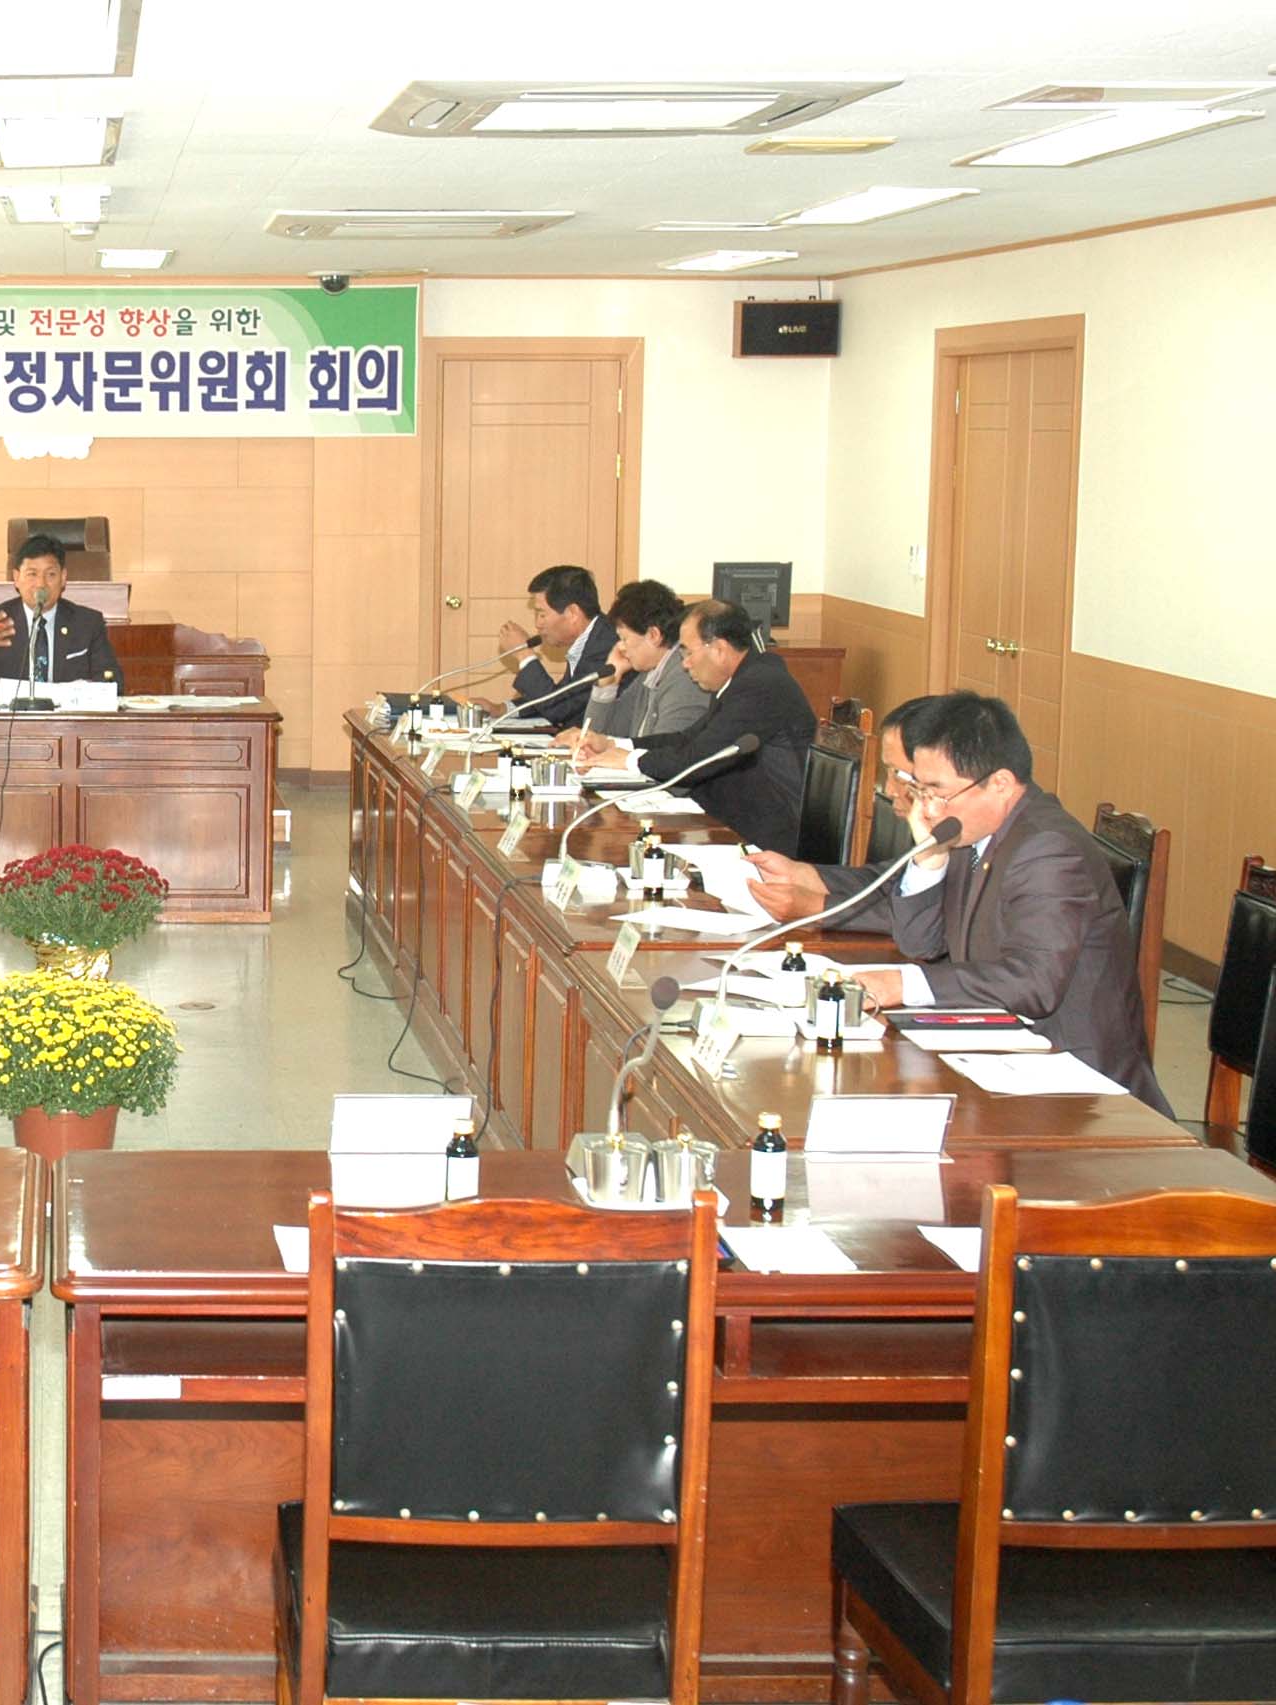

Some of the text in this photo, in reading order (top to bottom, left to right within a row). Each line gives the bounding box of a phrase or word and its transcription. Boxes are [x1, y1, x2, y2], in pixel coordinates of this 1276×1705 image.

[29, 309, 106, 337] 전문성
[120, 308, 197, 337] 향상을
[209, 308, 261, 336] 위한
[308, 350, 399, 412] 회의
